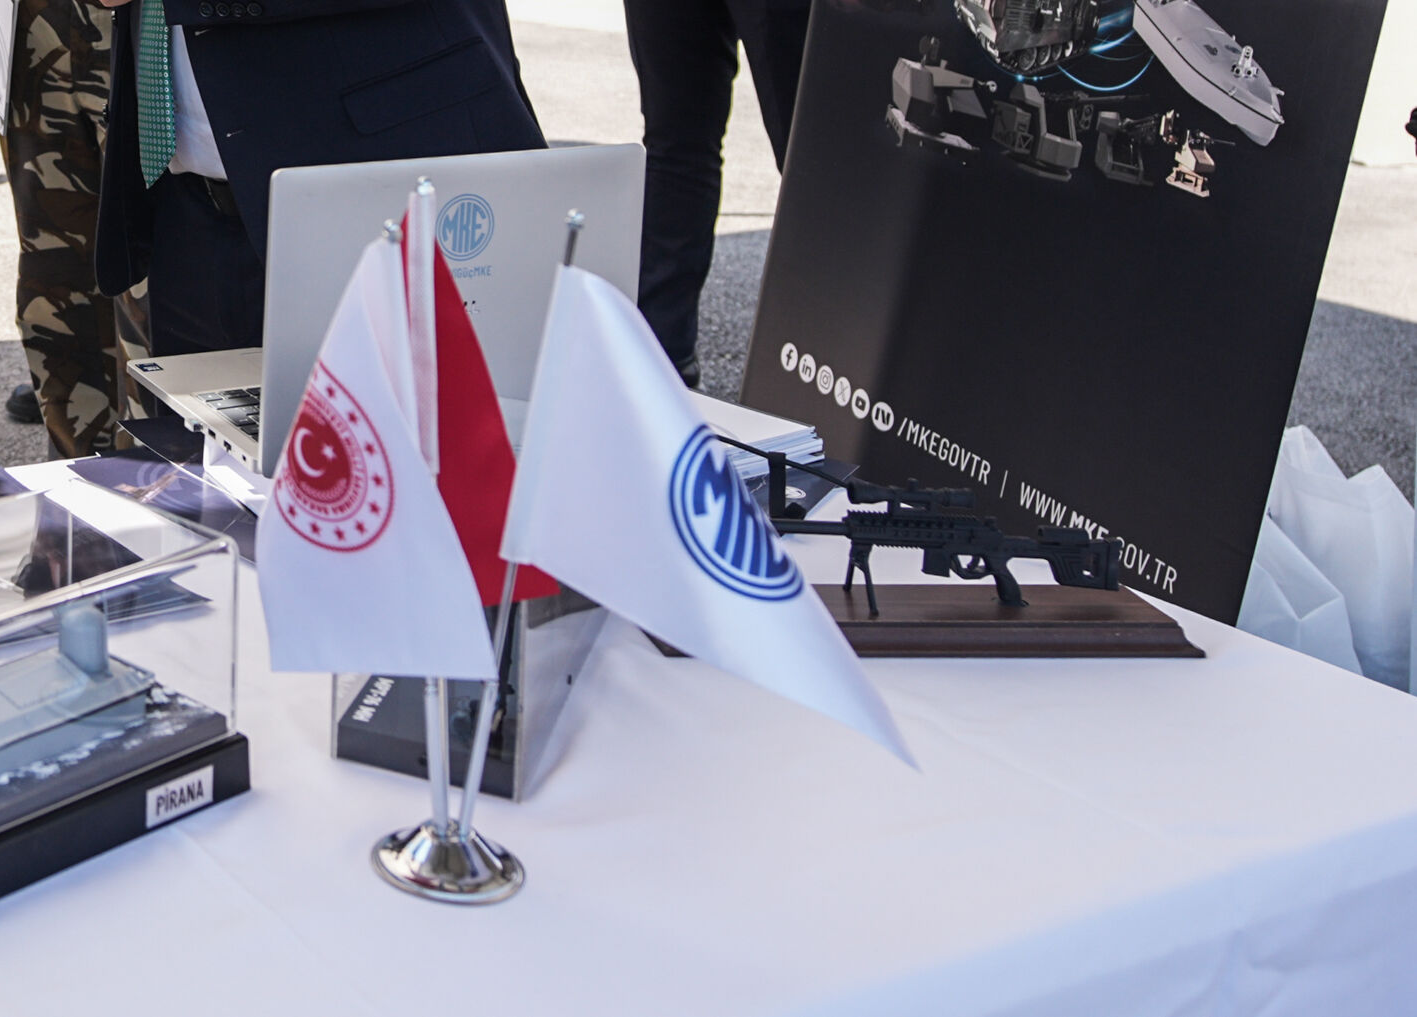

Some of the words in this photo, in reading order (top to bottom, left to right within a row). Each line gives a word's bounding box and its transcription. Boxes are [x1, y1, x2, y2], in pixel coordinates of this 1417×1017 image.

[442, 201, 486, 254] MKE
[897, 416, 992, 485] /MKEGOVTR
[1019, 481, 1177, 594] WWW.MKEGOV.TR
[153, 778, 206, 819] PİRANA
